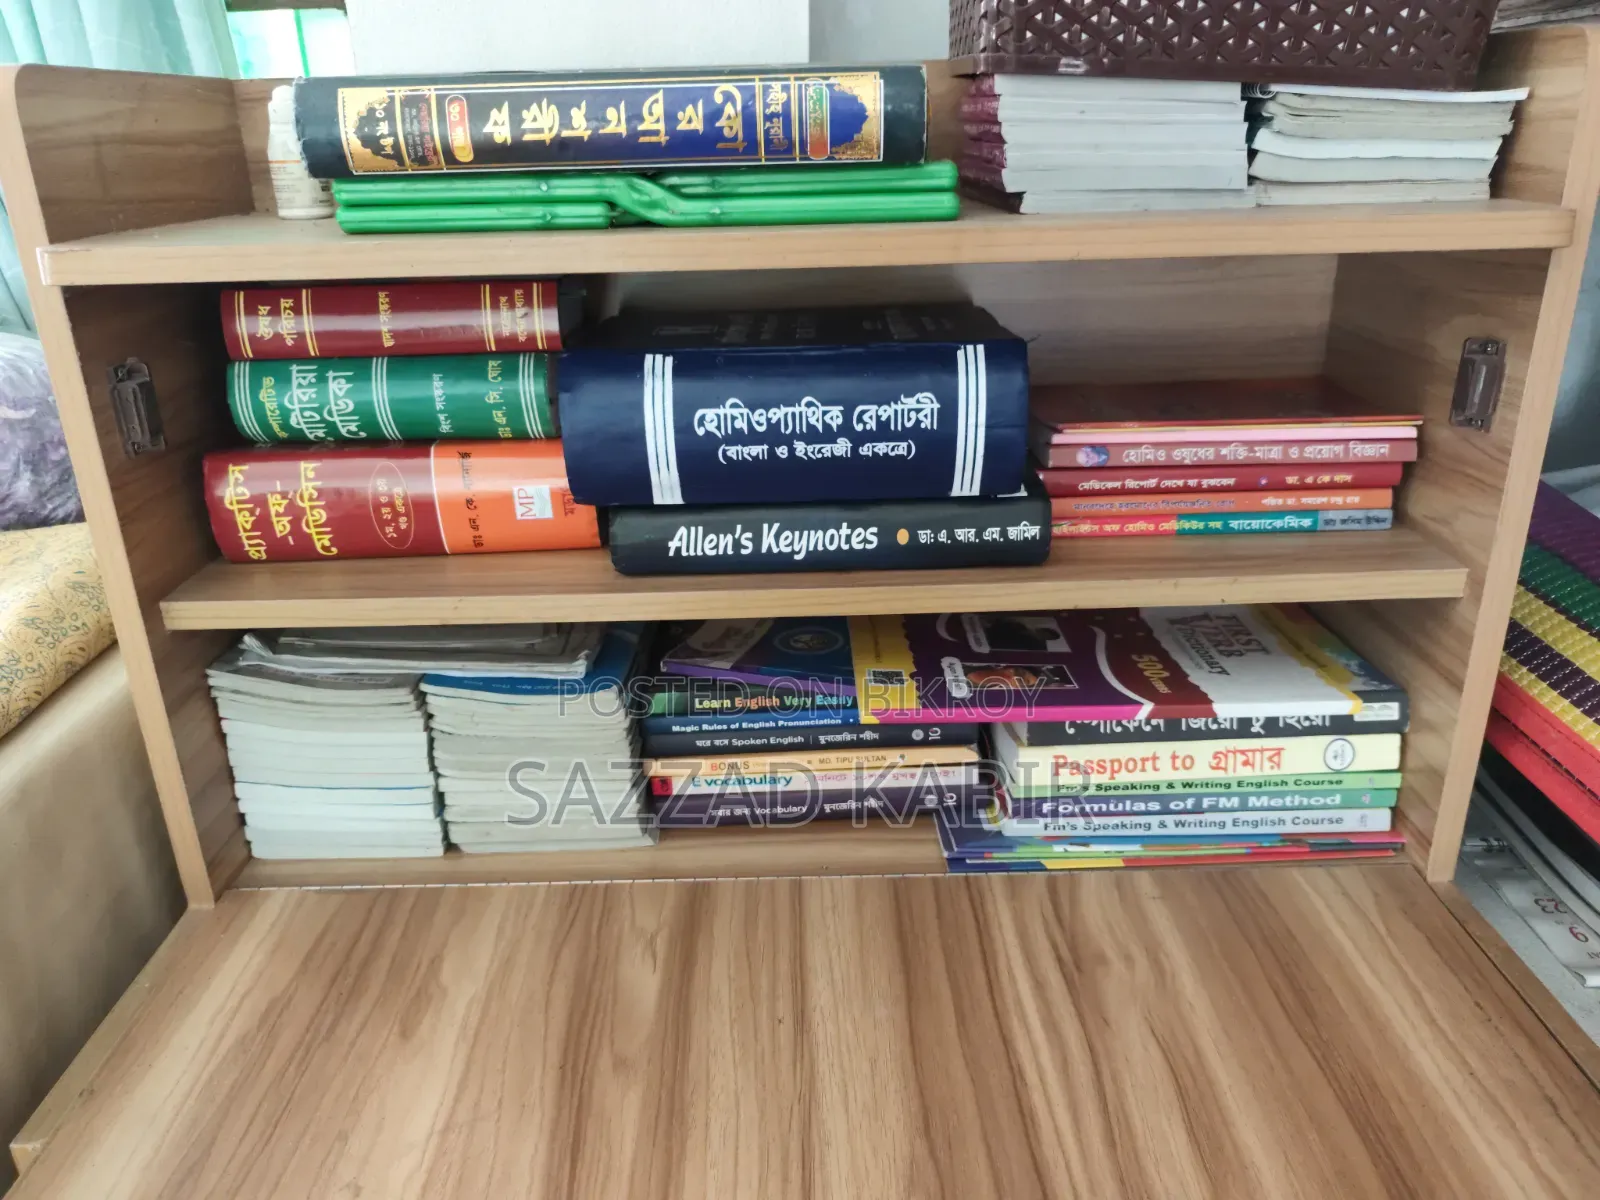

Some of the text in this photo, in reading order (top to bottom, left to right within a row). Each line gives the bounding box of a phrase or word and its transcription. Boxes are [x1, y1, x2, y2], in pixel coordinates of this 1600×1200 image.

[278, 298, 296, 347] পরিচয়
[431, 373, 446, 411] সংস্করণ
[323, 370, 367, 438] মেডিকা
[693, 392, 941, 439] হোমিওপ্যাথিক রেপার্টরী
[718, 437, 916, 465] (বাংলা ও ইংরেজী একত্রে)
[1121, 444, 1167, 464] হোমিও
[1288, 444, 1299, 460] ও
[1302, 443, 1345, 460] প্রয়োগ
[1348, 440, 1392, 459] বিজ্ঞান
[295, 460, 339, 556] মেডিসিন
[517, 487, 537, 518] MP
[937, 528, 952, 544] এ.
[954, 528, 980, 543] আর.
[982, 526, 1004, 542] এম.
[1006, 521, 1042, 541] জামিল
[1123, 519, 1155, 533] হোমিও
[1228, 516, 1313, 532] বায়োকেমিক
[668, 522, 879, 560] Allen's Keynotes
[695, 698, 731, 709] Learn
[734, 696, 780, 708] English
[783, 695, 812, 707] Very
[671, 718, 842, 735] Magic Rules of English Pronunciation
[731, 737, 768, 748] Spoken
[769, 735, 805, 746] English
[710, 760, 750, 772] BONUS
[818, 757, 833, 765] MD.
[1052, 745, 1286, 781] Passport to গ্রামার
[704, 774, 793, 789] vocabulary
[1094, 780, 1161, 793] Speaking
[1165, 780, 1176, 790] &
[1181, 778, 1232, 792] Writing
[1236, 776, 1289, 789] English
[1293, 776, 1344, 787] Course
[755, 805, 807, 816] Vocabulary
[1173, 796, 1195, 811] of
[1202, 796, 1241, 810] FM
[1248, 793, 1342, 808] Method
[1044, 821, 1079, 832] Fm's
[1083, 818, 1150, 835] Speaking
[1157, 818, 1168, 829] &
[1174, 816, 1226, 832] Writing
[1232, 815, 1286, 831] English
[1290, 814, 1344, 827] Course
